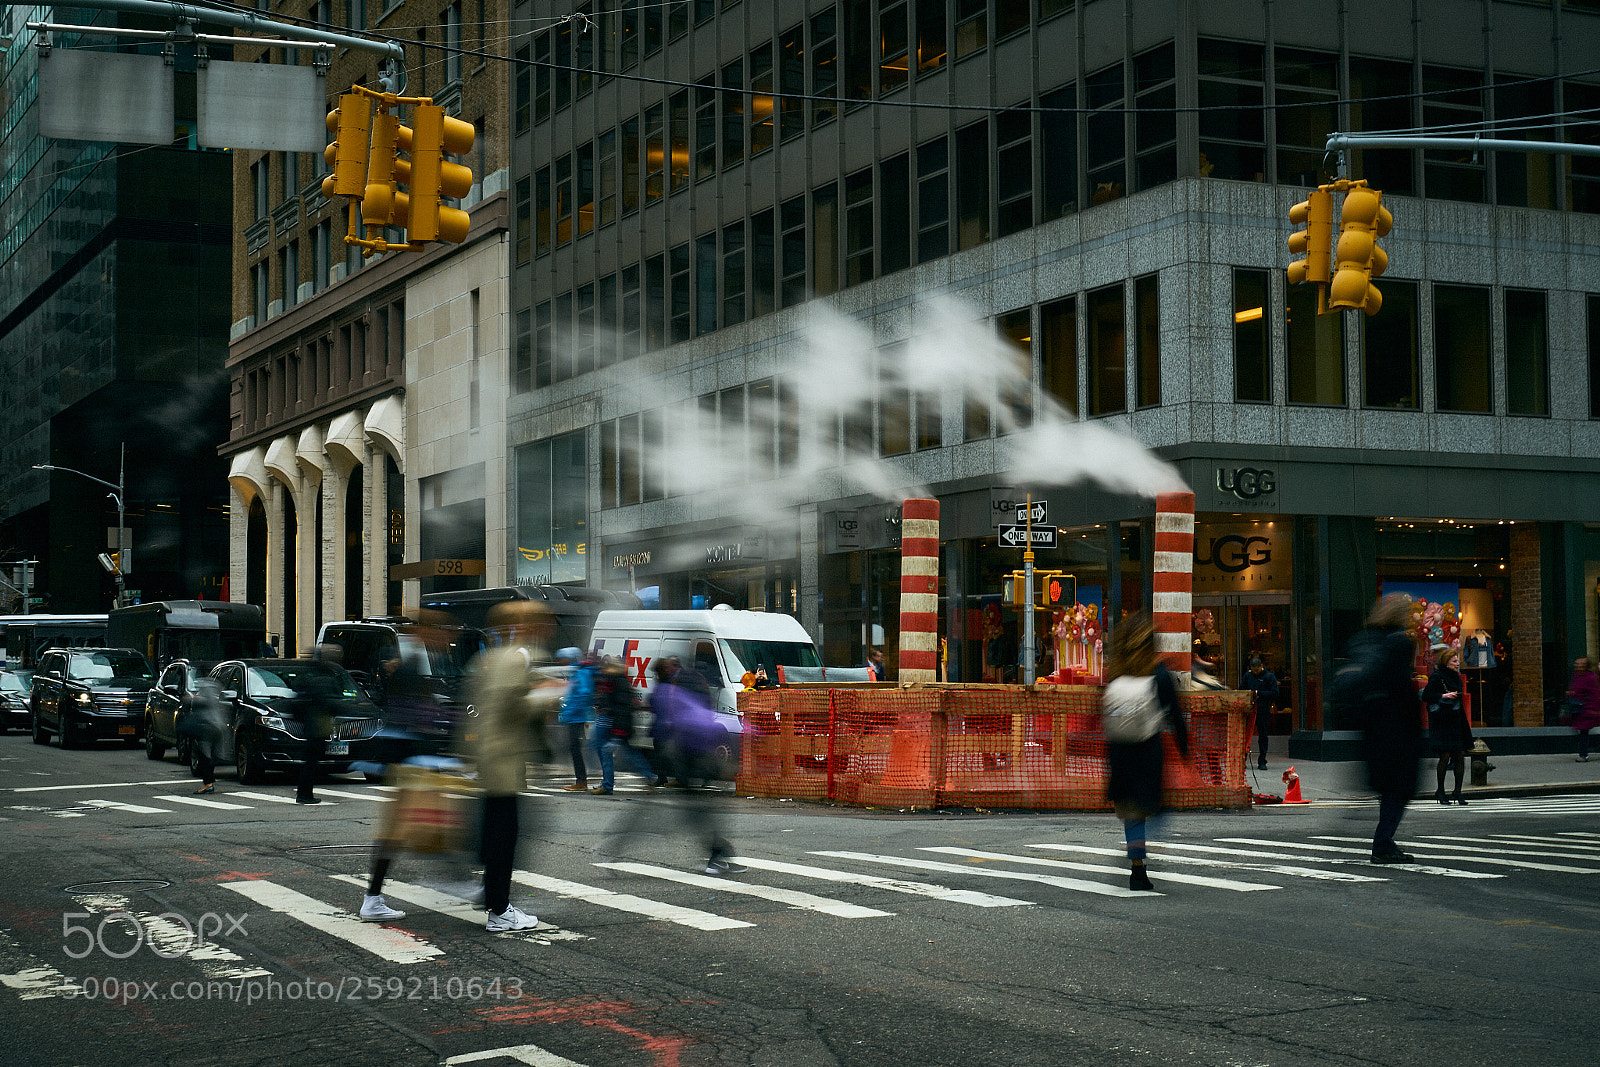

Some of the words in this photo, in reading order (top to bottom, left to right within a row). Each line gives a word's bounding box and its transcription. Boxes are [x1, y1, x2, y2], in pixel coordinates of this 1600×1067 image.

[1216, 467, 1276, 499] UGG
[992, 500, 1015, 512] UGG
[391, 509, 403, 545] FENDI
[839, 520, 858, 530] UGG
[1008, 531, 1025, 541] ONE
[1031, 532, 1049, 541] WAY
[1193, 534, 1272, 573] UGG
[437, 560, 463, 574] 598
